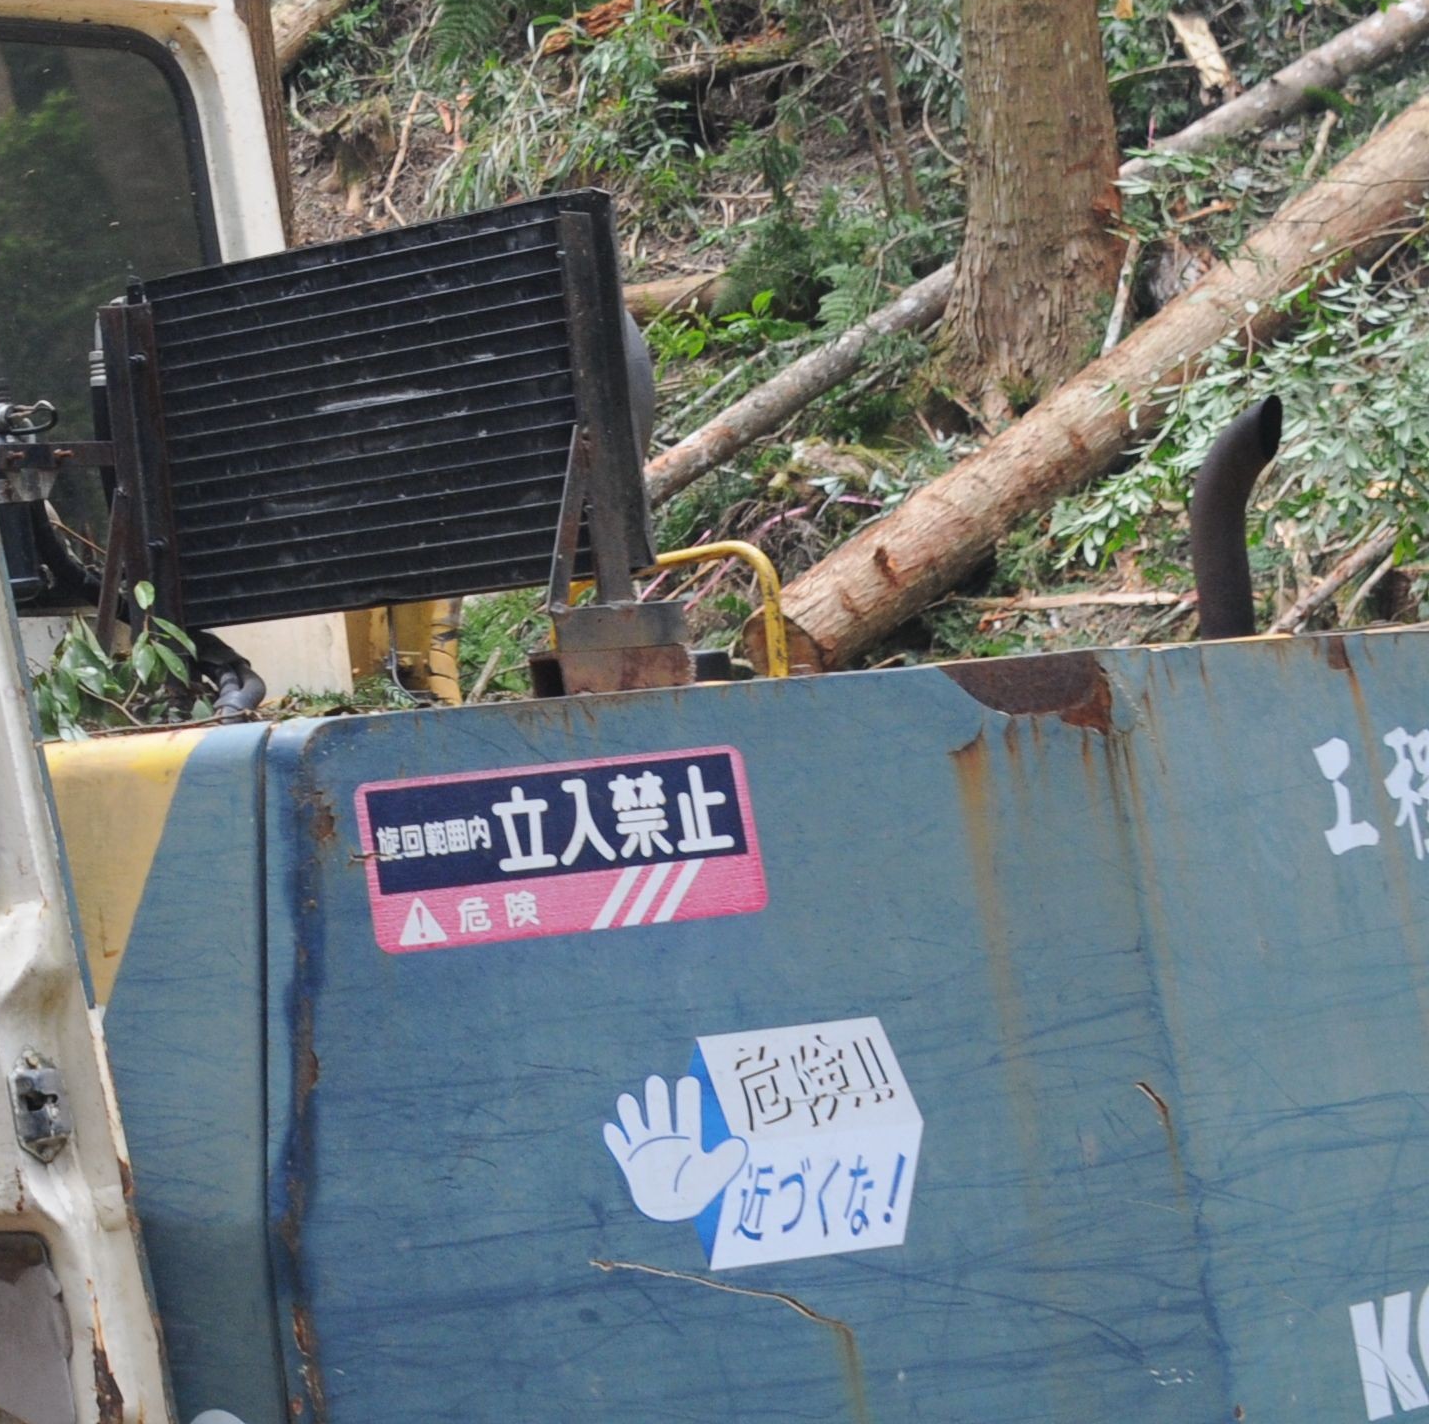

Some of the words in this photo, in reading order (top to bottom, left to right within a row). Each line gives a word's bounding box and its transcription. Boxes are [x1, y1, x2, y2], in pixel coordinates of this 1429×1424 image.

[376, 815, 493, 862] 旋回範囲内
[491, 765, 735, 873] 立入禁止
[456, 890, 541, 934] 危険
[732, 1152, 907, 1242] 近づくな!
[1349, 1284, 1429, 1422] K
